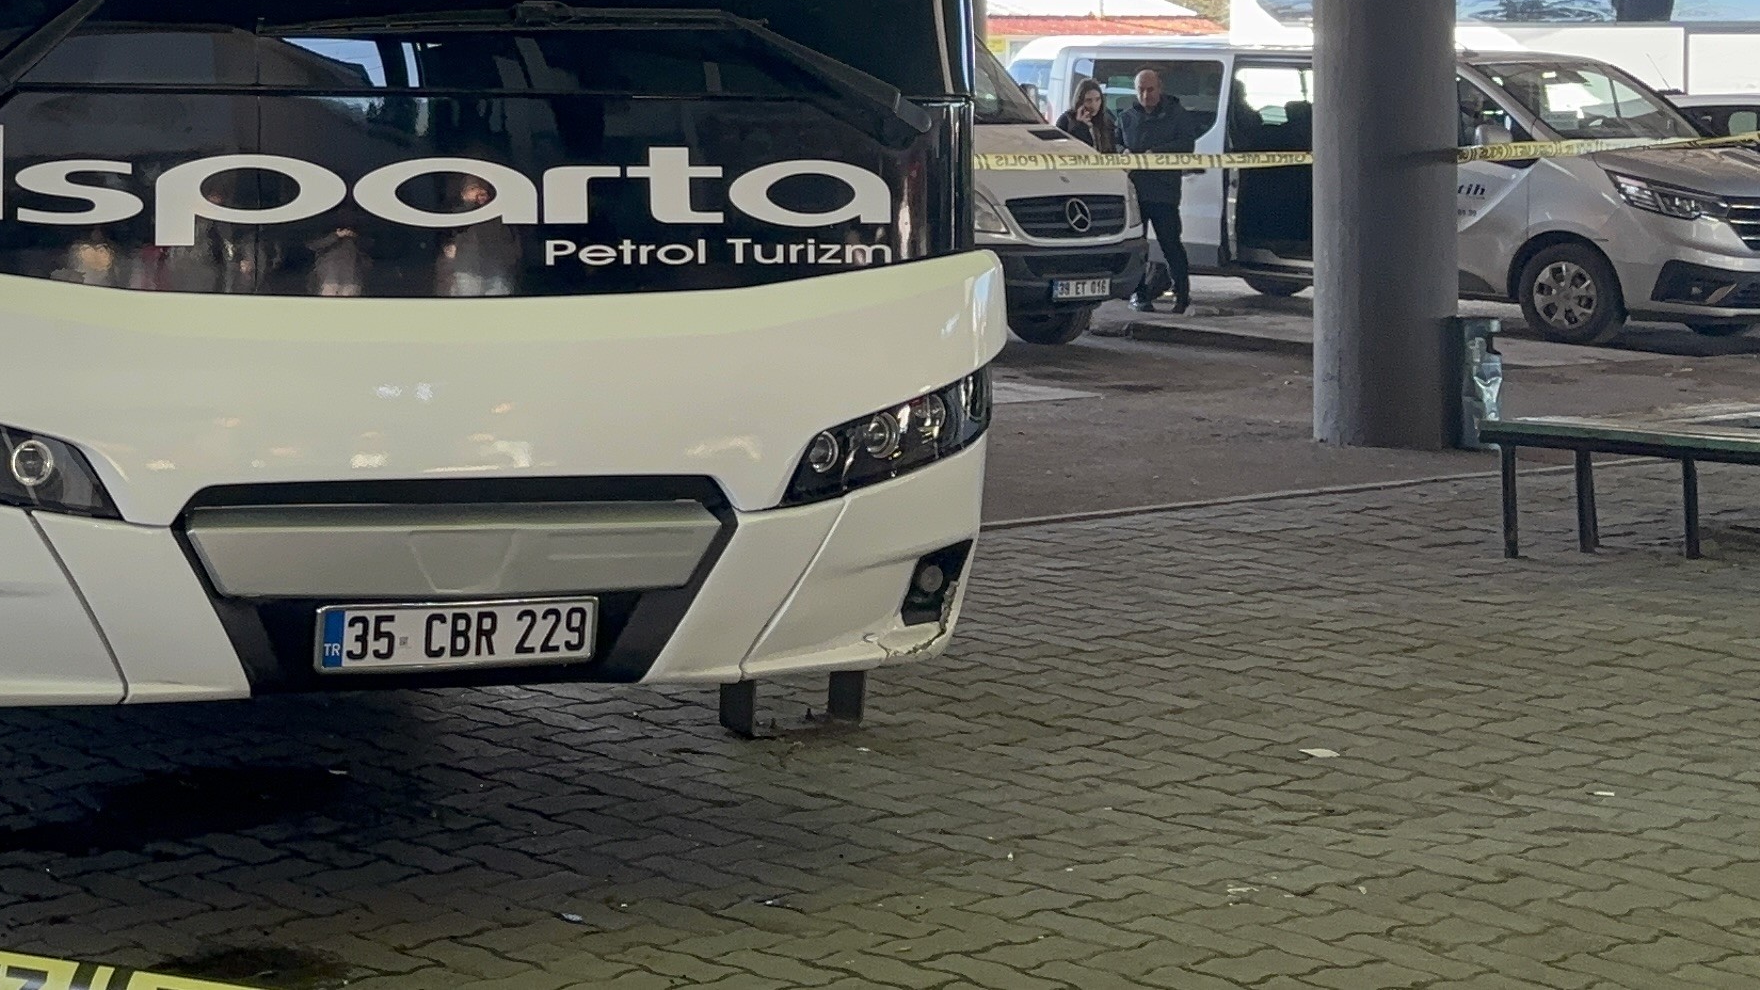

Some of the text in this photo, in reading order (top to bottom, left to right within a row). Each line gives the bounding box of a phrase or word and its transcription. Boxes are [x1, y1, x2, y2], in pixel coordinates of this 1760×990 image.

[545, 238, 891, 266] Petrol Turizm
[323, 607, 588, 660] TR 35 CBR 229
